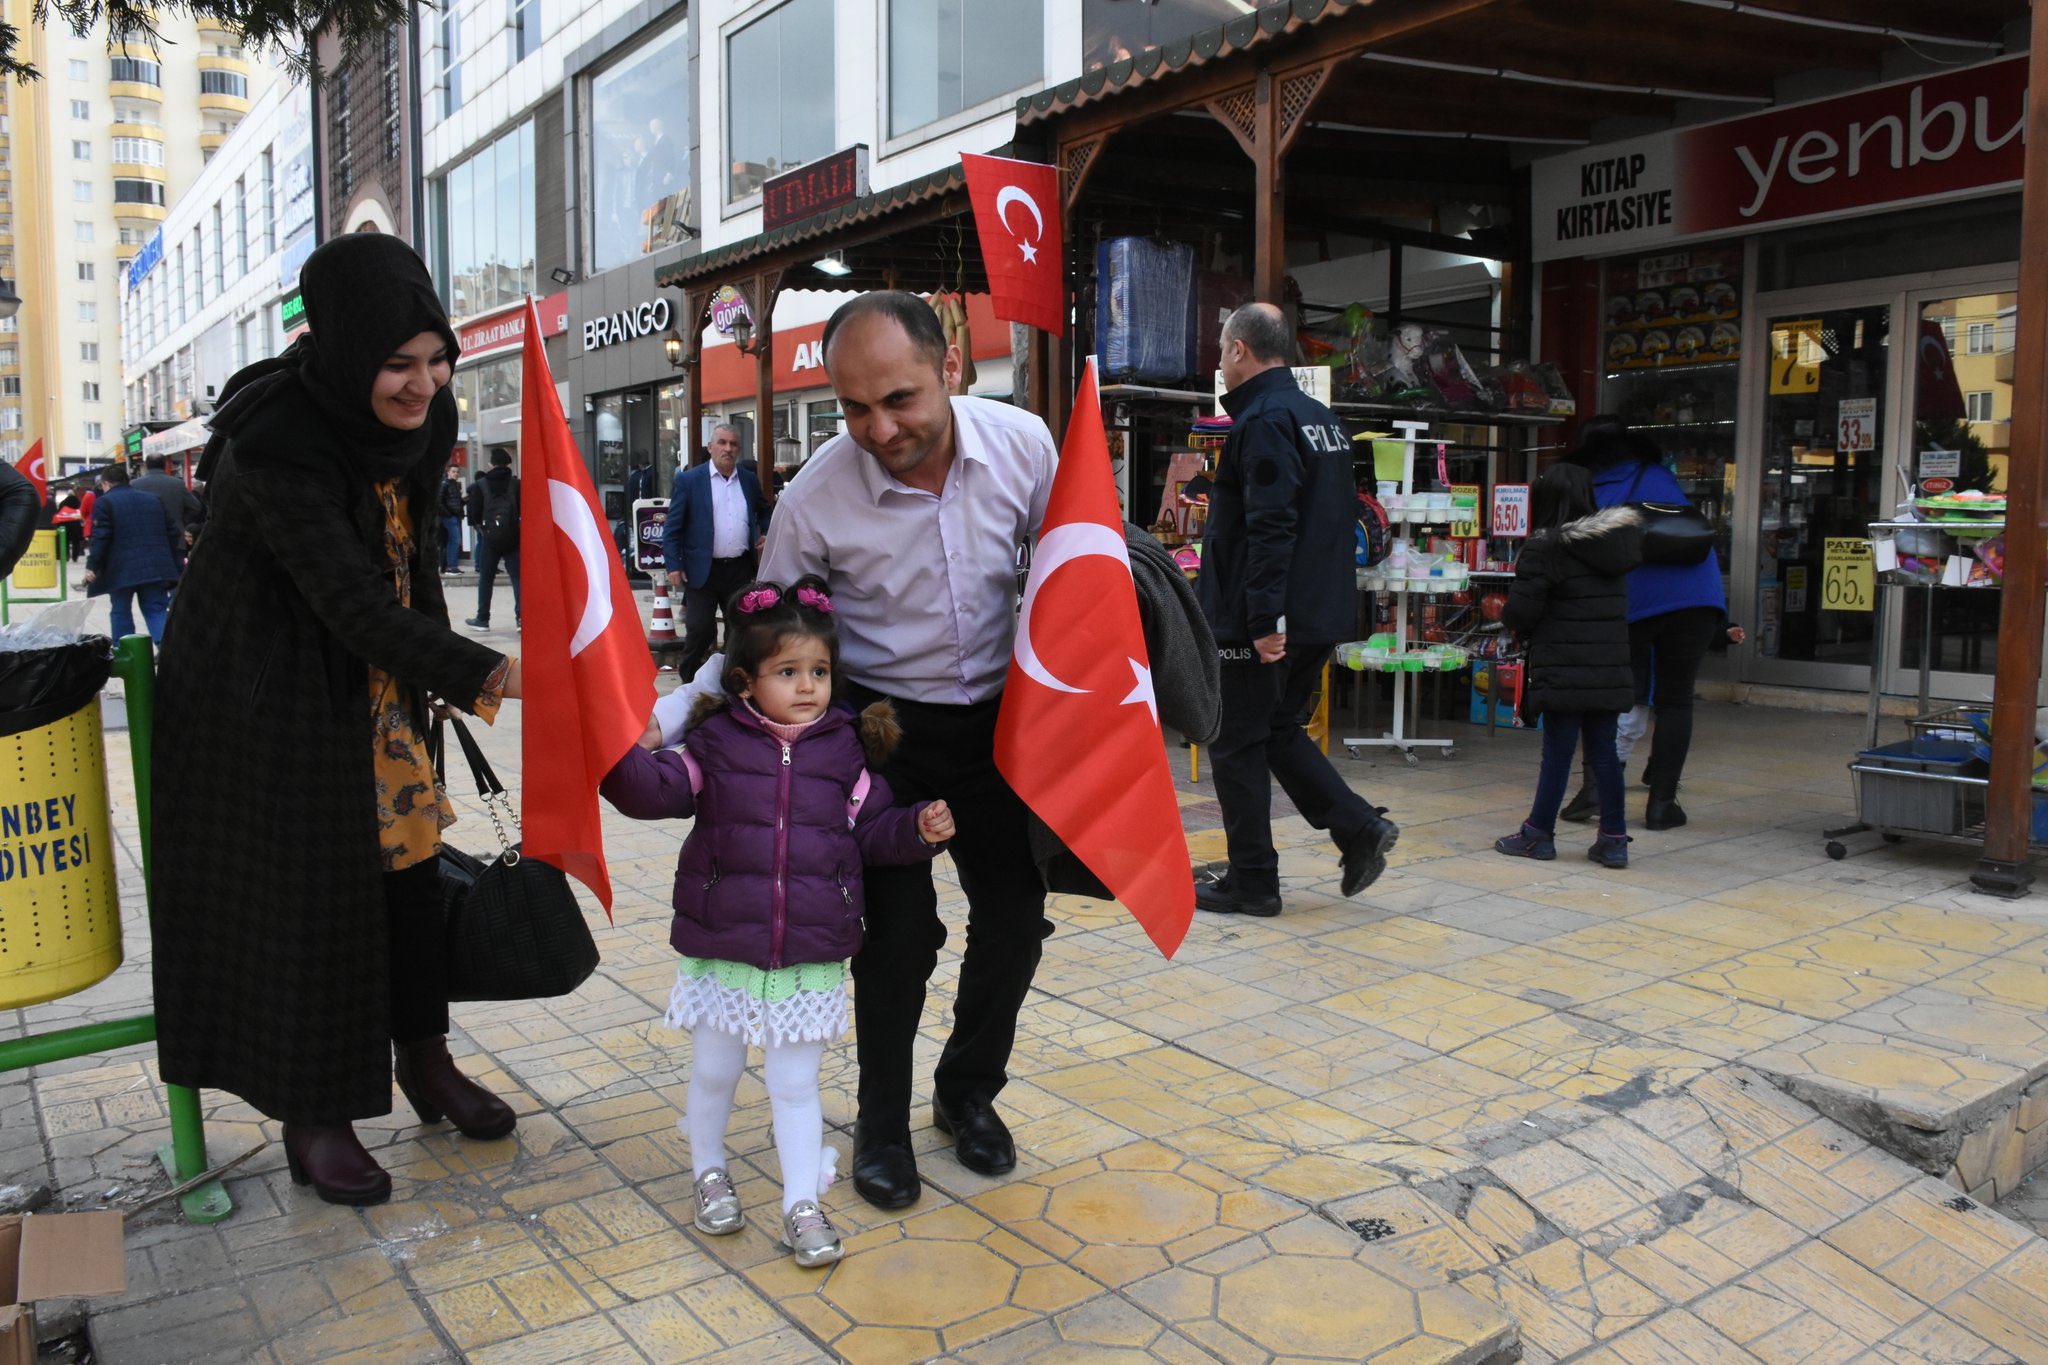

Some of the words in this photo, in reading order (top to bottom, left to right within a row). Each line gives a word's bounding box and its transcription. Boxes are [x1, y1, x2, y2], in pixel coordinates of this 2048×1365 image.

[1581, 153, 1645, 197] KİTAP
[1557, 189, 1672, 241] KIRTASİYE
[474, 328, 499, 347] ZİRAAT
[583, 297, 670, 352] BRANGO
[1495, 503, 1519, 532] 6.50
[1825, 565, 1858, 605] 65
